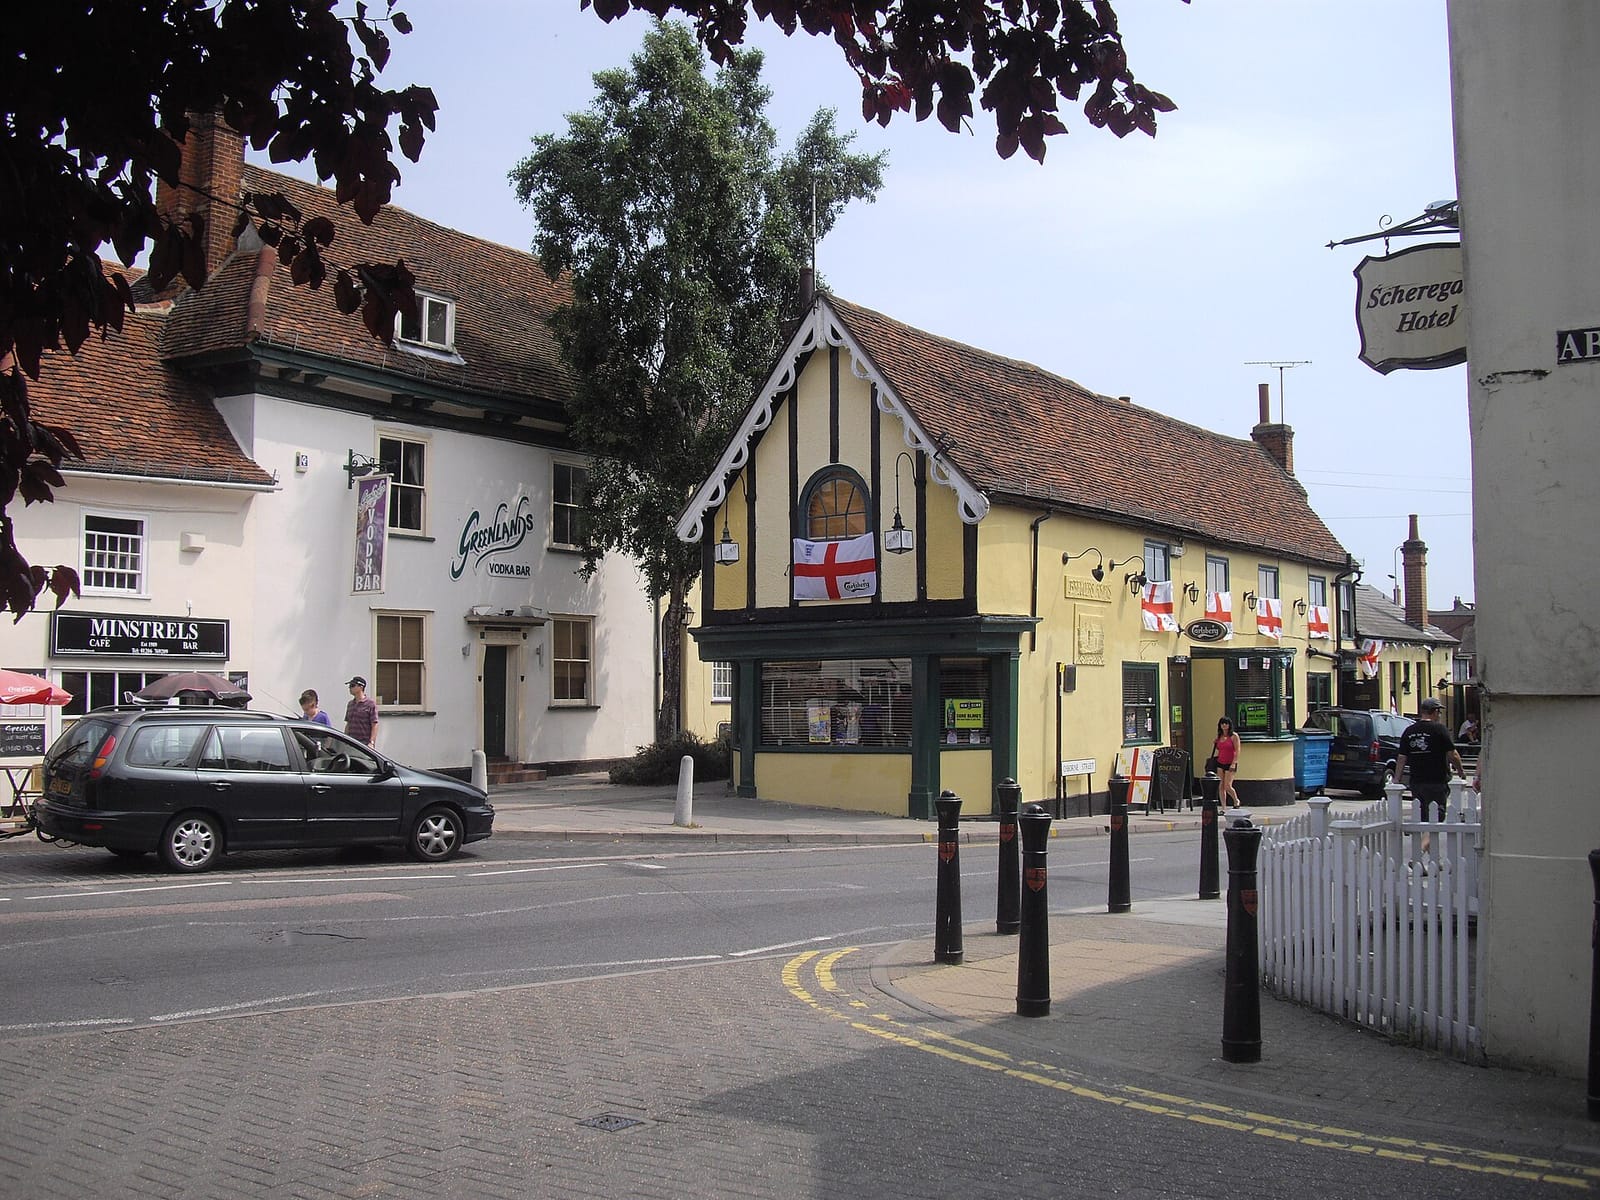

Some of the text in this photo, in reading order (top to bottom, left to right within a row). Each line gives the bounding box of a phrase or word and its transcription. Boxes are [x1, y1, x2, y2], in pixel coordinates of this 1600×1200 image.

[1395, 304, 1458, 332] Hotel
[1560, 331, 1600, 360] AB
[489, 563, 531, 576] VODKA BAR
[355, 574, 380, 591] BAR
[843, 578, 870, 593] Carlsberg
[90, 618, 198, 640] MINSTRELS
[1191, 624, 1219, 638] Carlsberg
[182, 641, 199, 650] BAR
